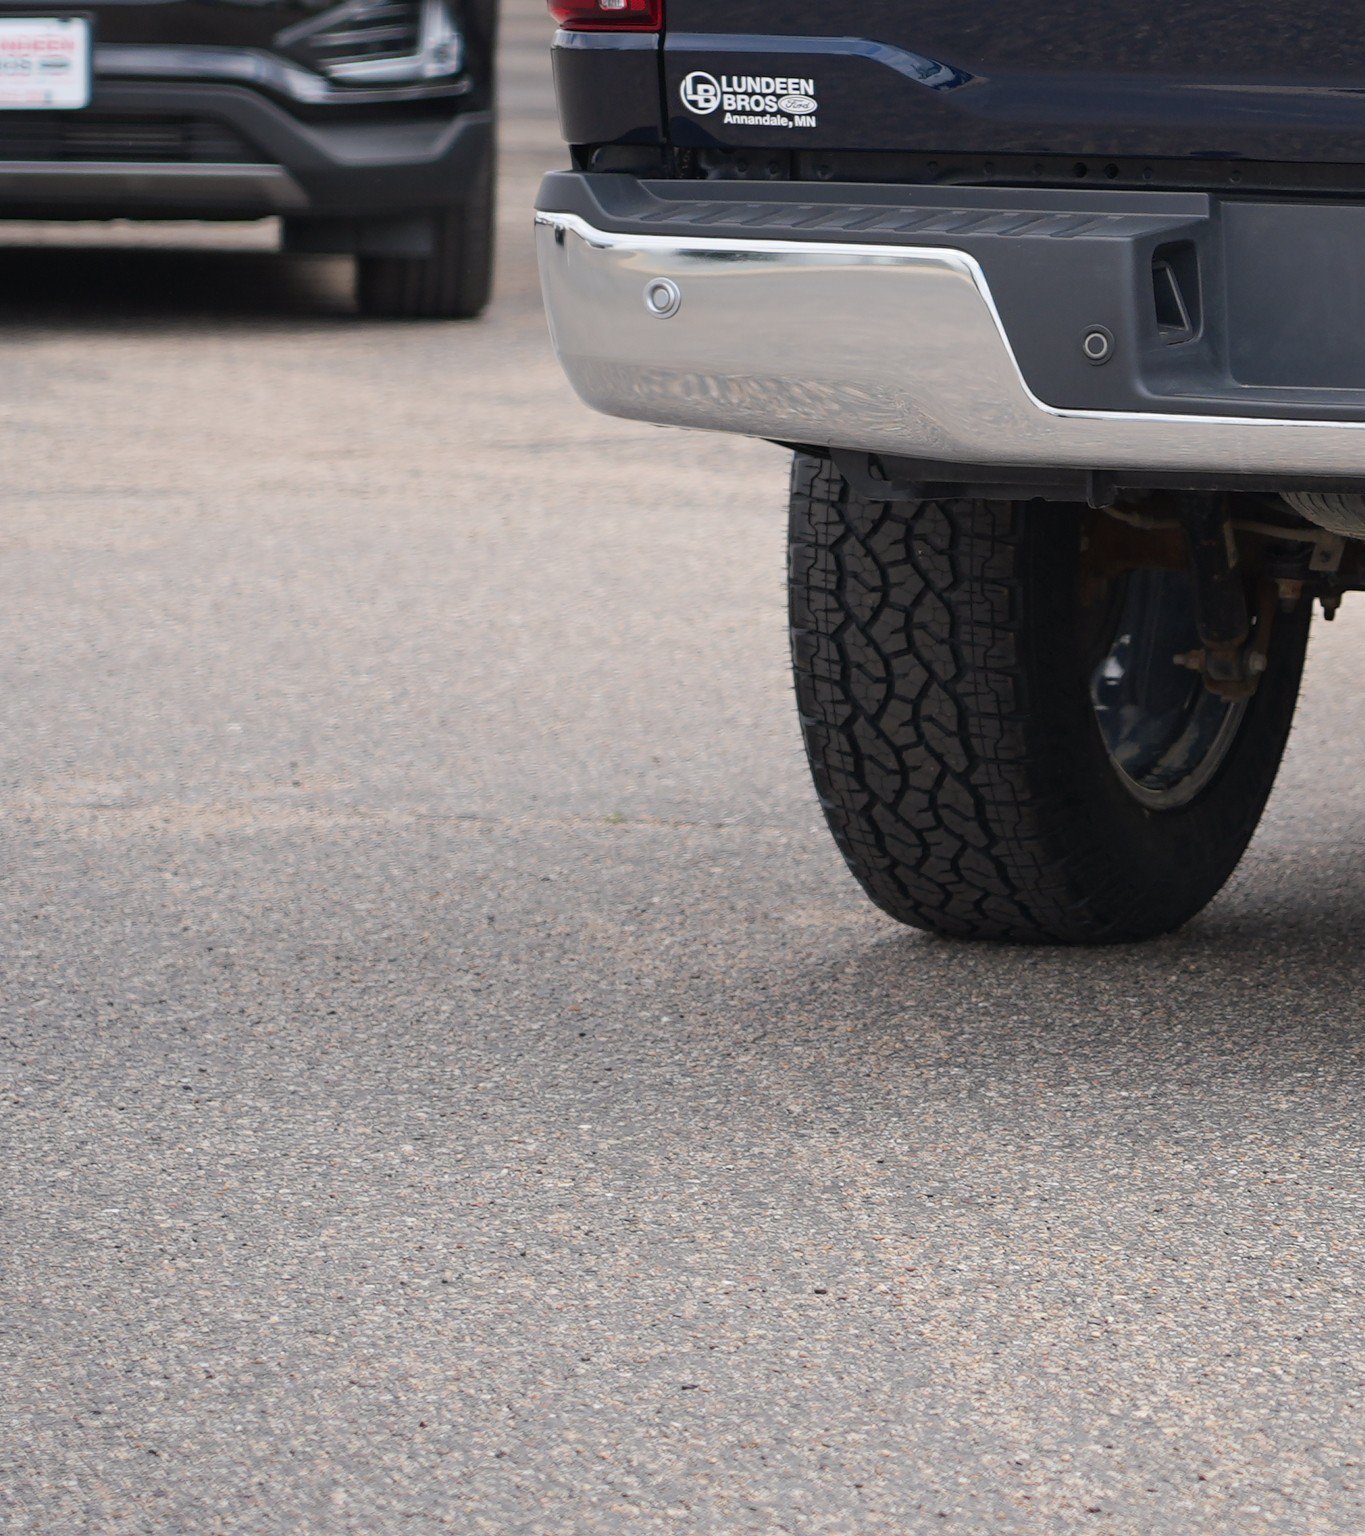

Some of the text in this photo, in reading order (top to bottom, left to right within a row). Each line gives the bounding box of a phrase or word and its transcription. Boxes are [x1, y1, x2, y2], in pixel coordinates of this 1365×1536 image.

[721, 75, 814, 94] LUNDEEN
[723, 95, 778, 112] BROS
[724, 113, 816, 128] Annandale, MN
